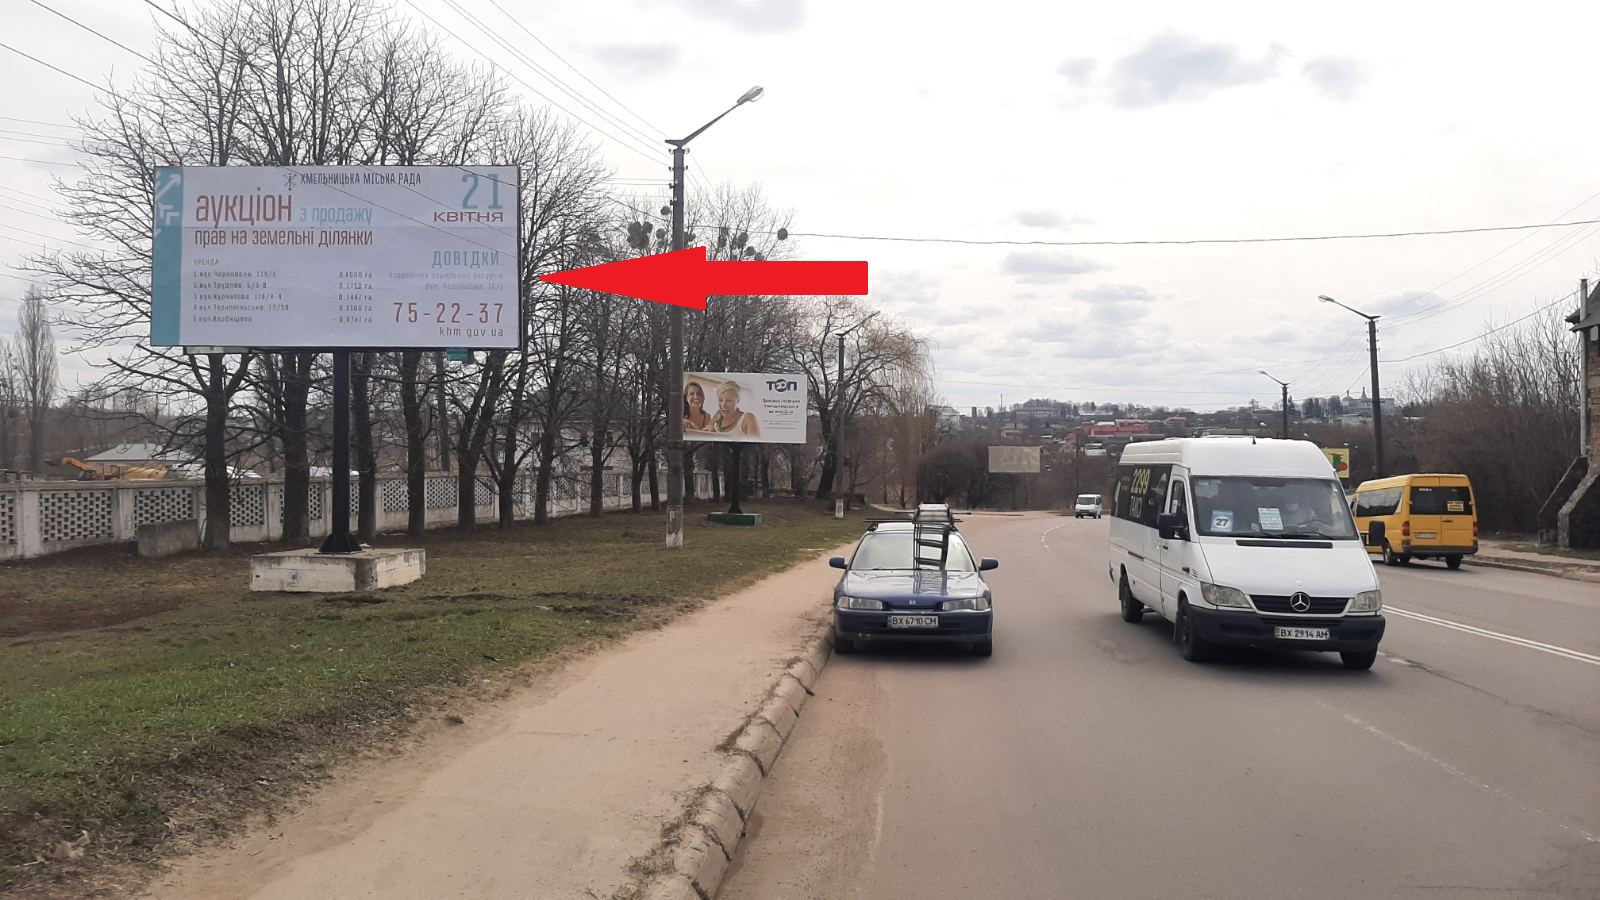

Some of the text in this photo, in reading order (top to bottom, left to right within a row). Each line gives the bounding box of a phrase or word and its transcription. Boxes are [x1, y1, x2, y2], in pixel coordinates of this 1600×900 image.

[300, 172, 421, 187] ХМЕЛЬНИЦЬКА МІСЬКА РАДА
[462, 173, 503, 209] 21
[195, 186, 373, 229] аукціон з продажу
[433, 211, 504, 222] КВІТНЯ
[195, 227, 373, 248] прав на земельні ділянки
[393, 302, 503, 324] 75-22-37
[440, 326, 504, 338] khm.gov.ua
[1130, 468, 1151, 495] 2299
[1215, 518, 1229, 527] 27
[1294, 629, 1314, 638] 2914
